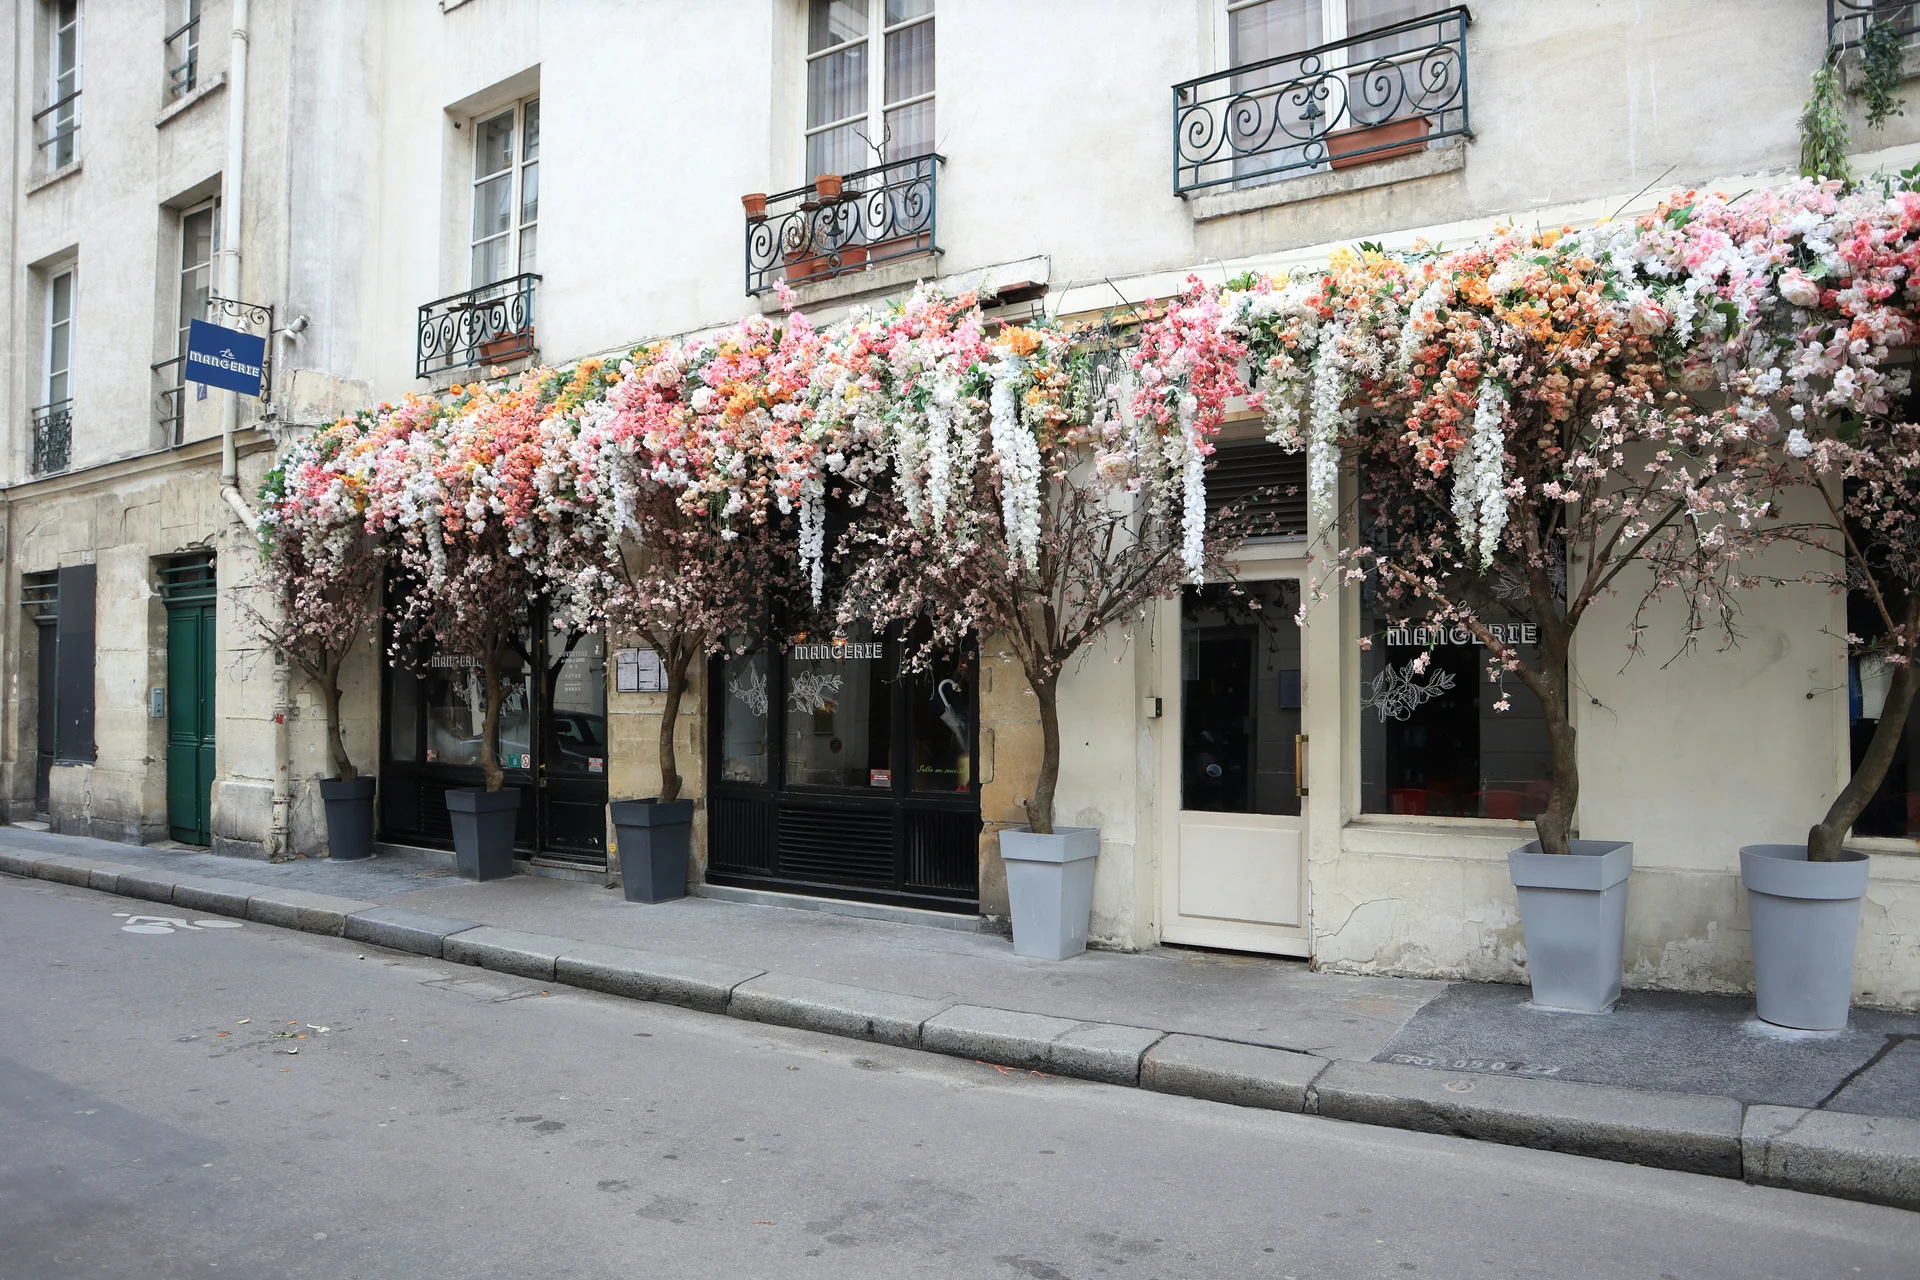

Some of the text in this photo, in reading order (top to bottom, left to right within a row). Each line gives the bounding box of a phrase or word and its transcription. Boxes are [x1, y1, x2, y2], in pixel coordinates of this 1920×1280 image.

[219, 348, 236, 360] La
[189, 350, 260, 377] MANGERIE
[829, 625, 849, 641] La
[794, 642, 883, 660] MANGERIE
